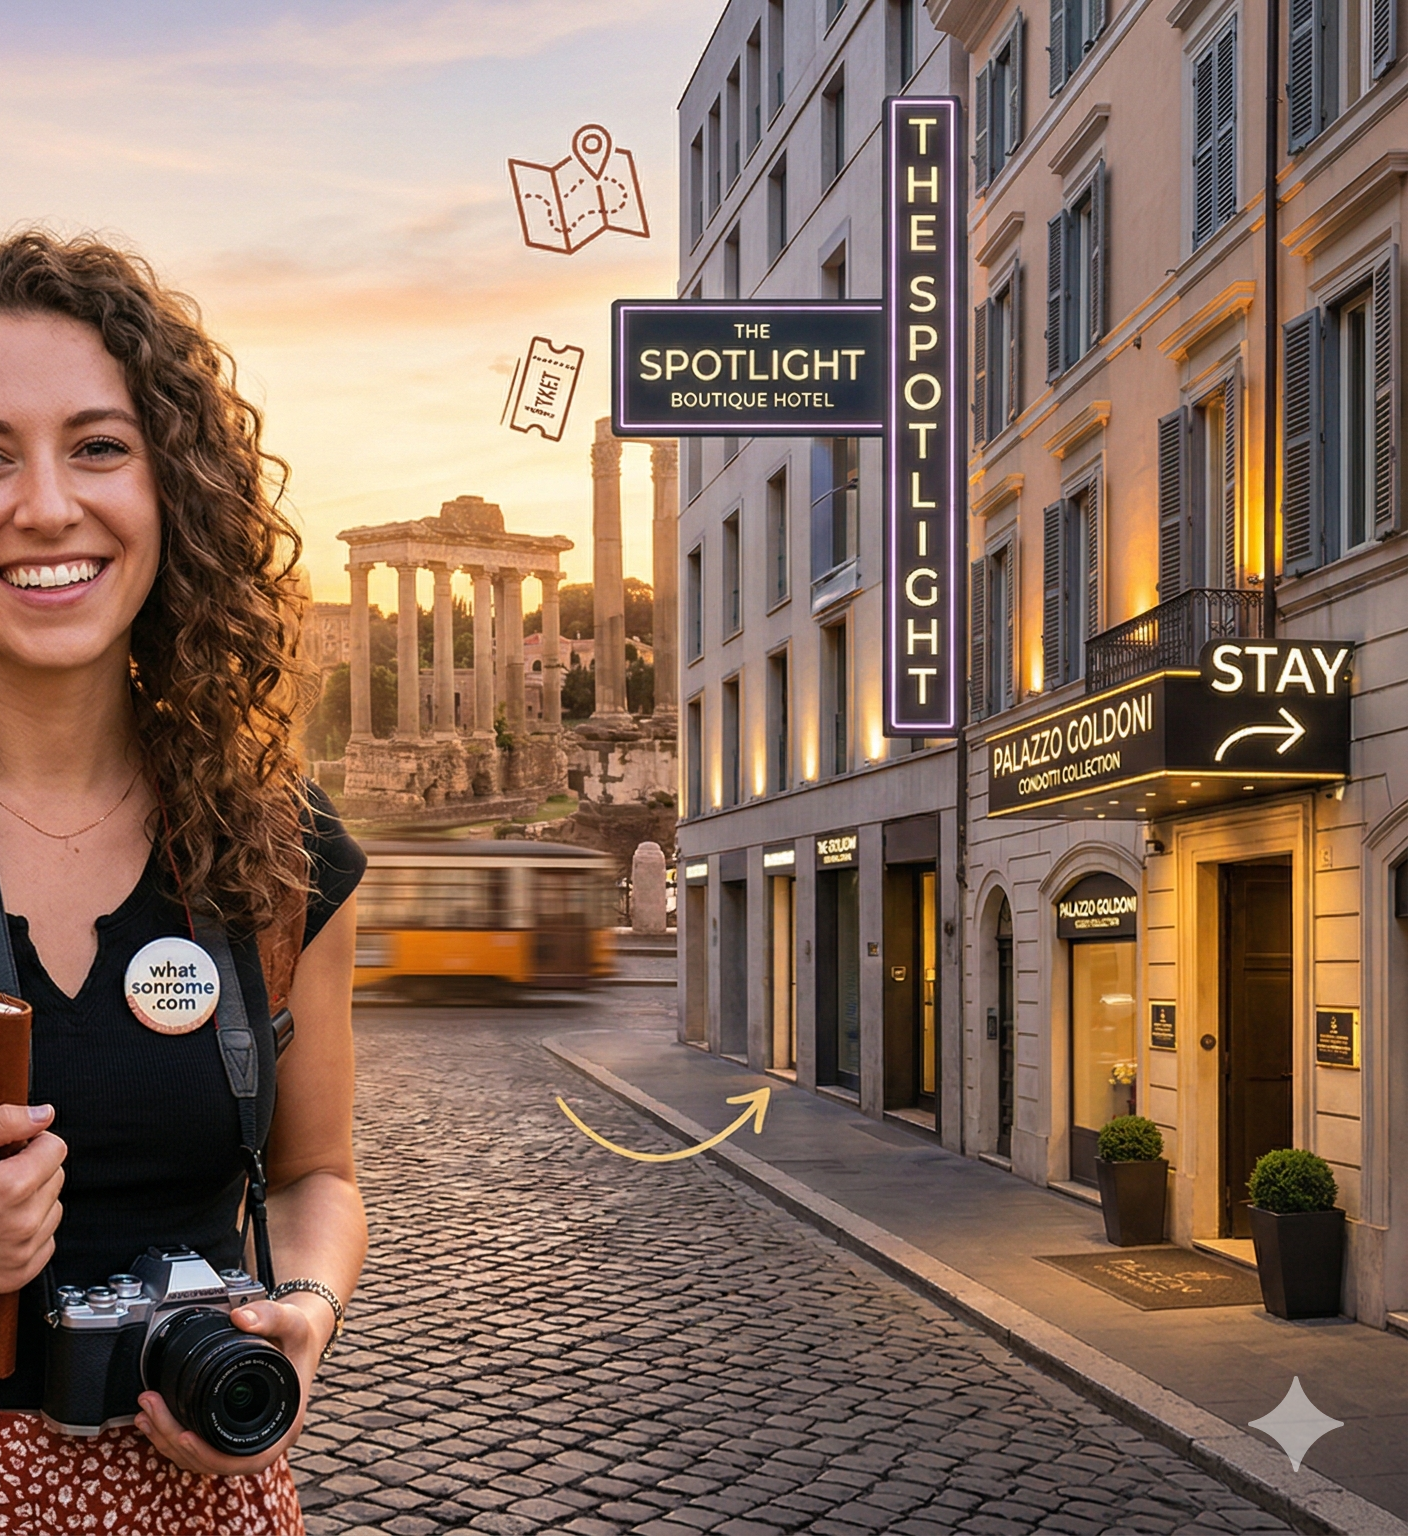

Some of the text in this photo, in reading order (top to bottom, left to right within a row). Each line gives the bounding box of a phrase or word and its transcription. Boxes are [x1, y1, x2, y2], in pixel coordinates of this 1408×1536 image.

[907, 118, 938, 251] THE
[733, 323, 771, 339] THE
[639, 349, 866, 381] SPOTLIGHT
[671, 392, 835, 410] BOUTIQUE HOTEL
[904, 275, 942, 705] SPOTLIGHT
[1210, 644, 1349, 695] STAY
[993, 692, 1153, 778] PALAZZO GOLDONI
[1018, 750, 1121, 795] CONDOTTI COLLECTION
[1097, 896, 1137, 916] GOLDONI
[149, 961, 197, 978] what
[132, 982, 215, 995] sonrome
[152, 998, 196, 1010] .com
